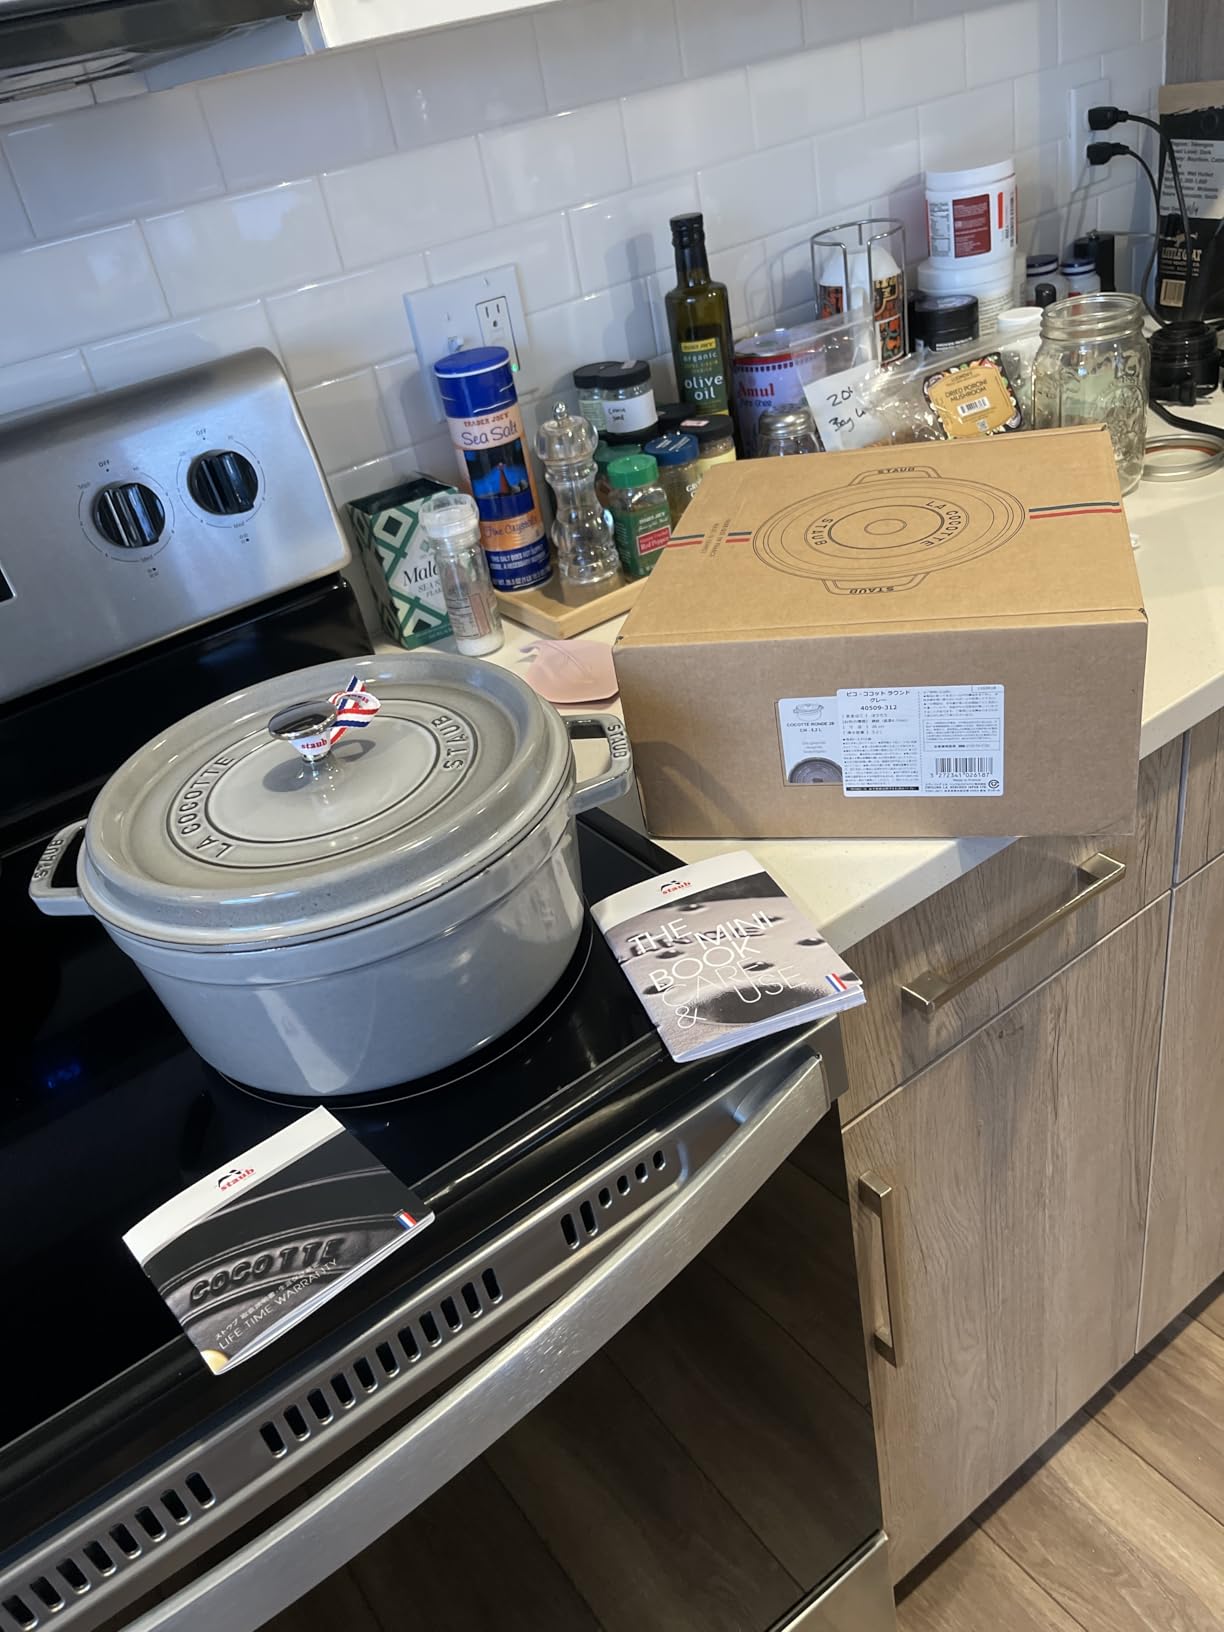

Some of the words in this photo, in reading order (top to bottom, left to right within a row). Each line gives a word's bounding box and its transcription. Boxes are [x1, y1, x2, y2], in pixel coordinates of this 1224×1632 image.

[683, 352, 718, 363] organic
[684, 375, 724, 389] olive
[694, 386, 716, 401] oil
[738, 382, 775, 398] Amul
[950, 386, 987, 401] MUSHROOM
[461, 431, 489, 446] Sea
[490, 419, 518, 441] Salt
[464, 418, 490, 427] TRADER
[878, 466, 915, 475] STAUB
[926, 500, 947, 510] LA
[811, 518, 834, 546] STAUB
[920, 510, 962, 547] COCOTTE
[849, 585, 895, 595] STAUB
[301, 737, 328, 750] staub
[431, 714, 467, 771] STAUB
[607, 723, 629, 760] STAUB
[177, 755, 236, 835] COCOTTE
[33, 838, 65, 879] STAUB
[196, 835, 233, 858] LA
[661, 881, 692, 895] staub
[627, 917, 693, 954] THE
[694, 910, 775, 951] MINI
[649, 936, 761, 992] BOOK
[662, 957, 762, 1007] CARE
[675, 1005, 707, 1029] &
[733, 965, 807, 1004] USE
[220, 1168, 255, 1191] staub
[190, 1237, 346, 1301] COCOTTE
[218, 1327, 243, 1350] LIFE
[244, 1303, 274, 1329] TIME
[273, 1258, 338, 1306] WARRANTY
